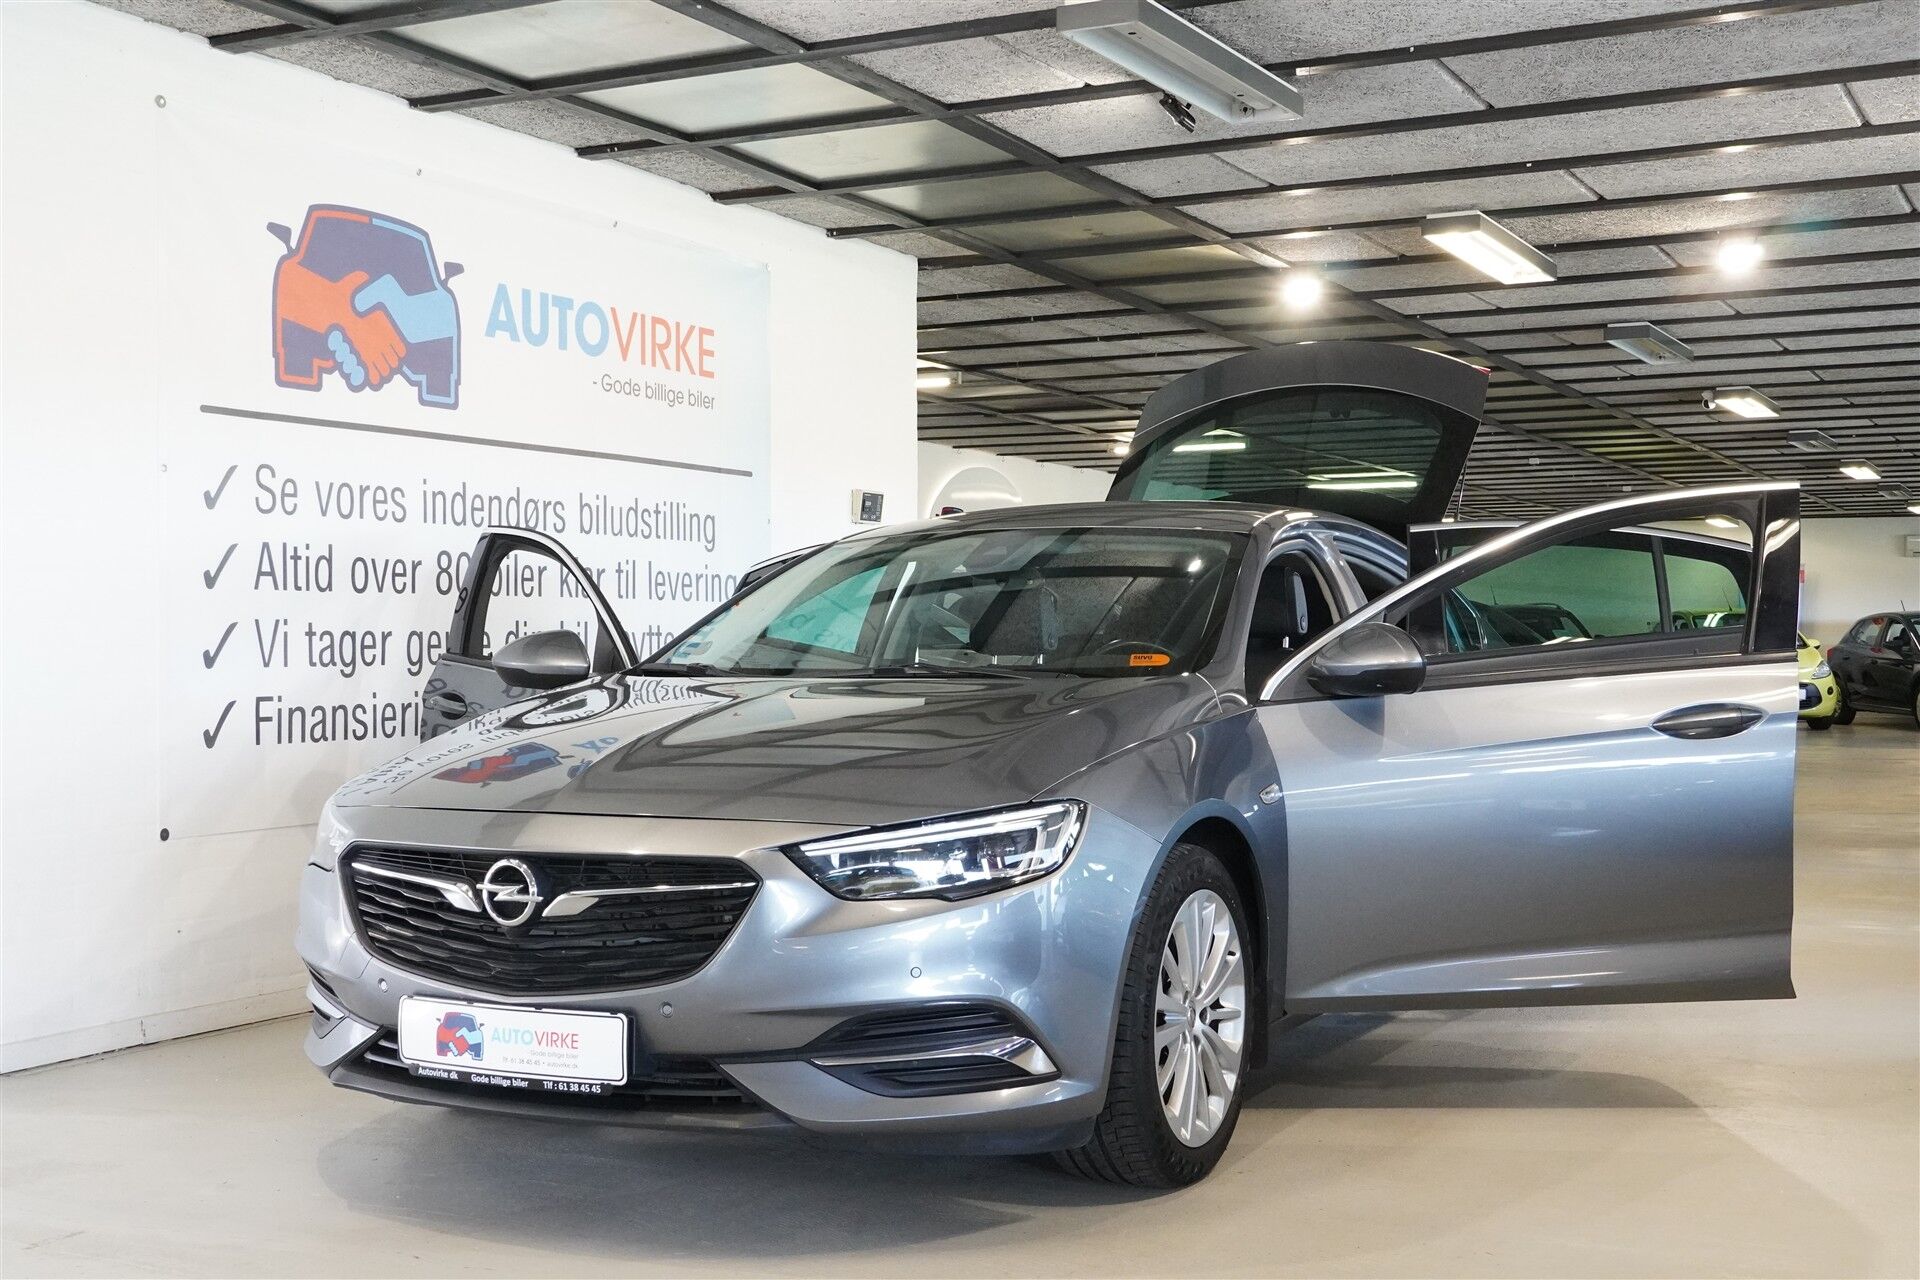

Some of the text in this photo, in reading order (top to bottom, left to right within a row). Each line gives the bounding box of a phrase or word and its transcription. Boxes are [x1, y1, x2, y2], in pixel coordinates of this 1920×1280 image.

[484, 282, 716, 380] AUTOVIRKE
[601, 373, 641, 397] Gode
[644, 381, 685, 407] billige
[687, 389, 716, 410] biler
[254, 463, 717, 552] Se vores indendørs biludstilling
[254, 541, 334, 595] Altid
[350, 556, 423, 597] over
[615, 559, 637, 600] til
[254, 618, 289, 669] Vi
[304, 621, 393, 680] tager
[491, 1027, 579, 1050] AUTOVIRKE
[471, 1074, 529, 1088] Gode billige biler
[543, 1081, 553, 1090] Tlf
[558, 1082, 568, 1091] 61
[569, 1083, 579, 1092] 38
[580, 1084, 590, 1093] 45
[591, 1085, 602, 1093] 45
